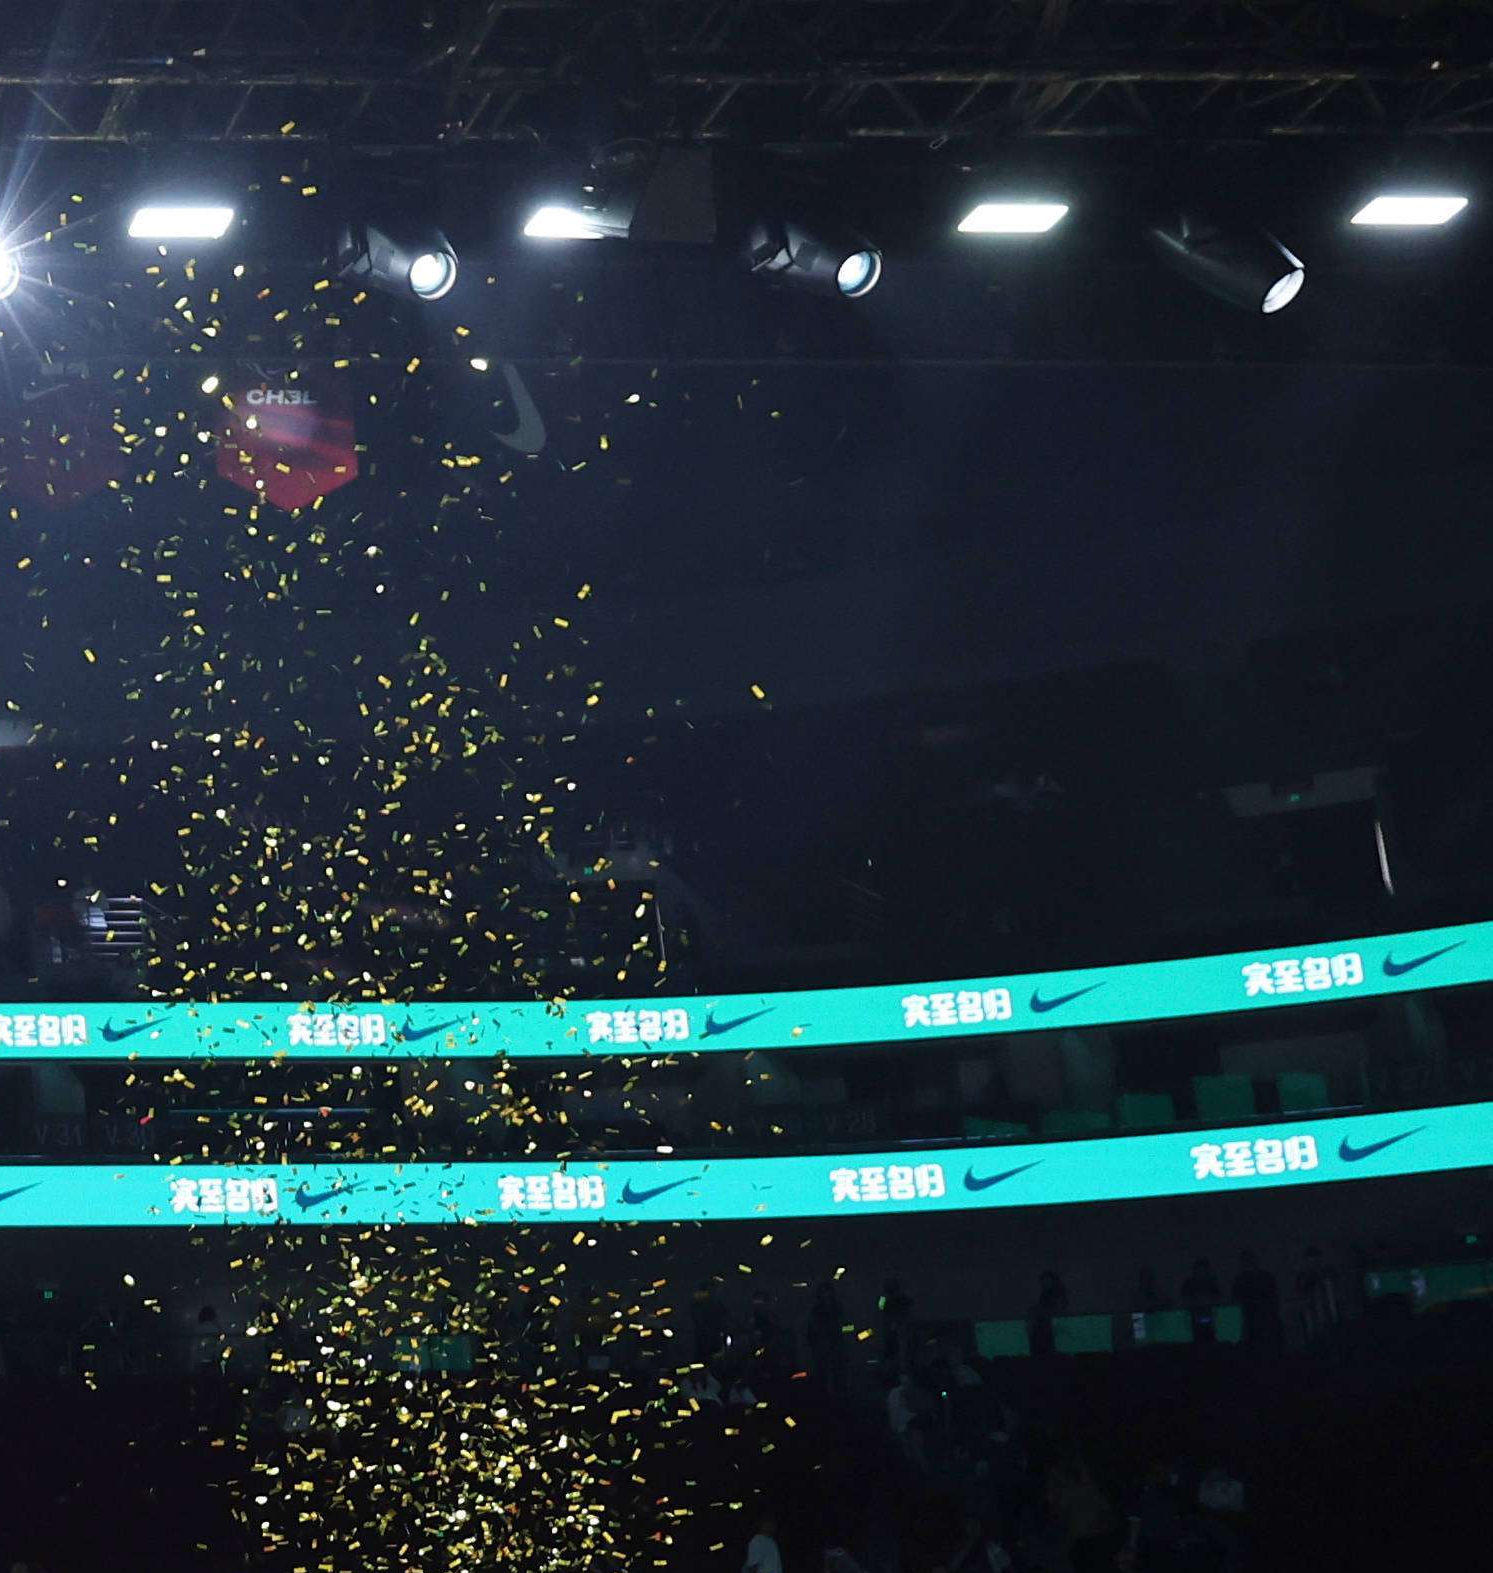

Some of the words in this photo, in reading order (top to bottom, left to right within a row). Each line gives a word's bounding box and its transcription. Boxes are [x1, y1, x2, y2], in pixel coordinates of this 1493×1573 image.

[1242, 953, 1363, 996] 实至名归
[901, 988, 1012, 1027] 实至名归
[1190, 1135, 1319, 1179] 实至名归
[829, 1163, 946, 1202] 实至名归
